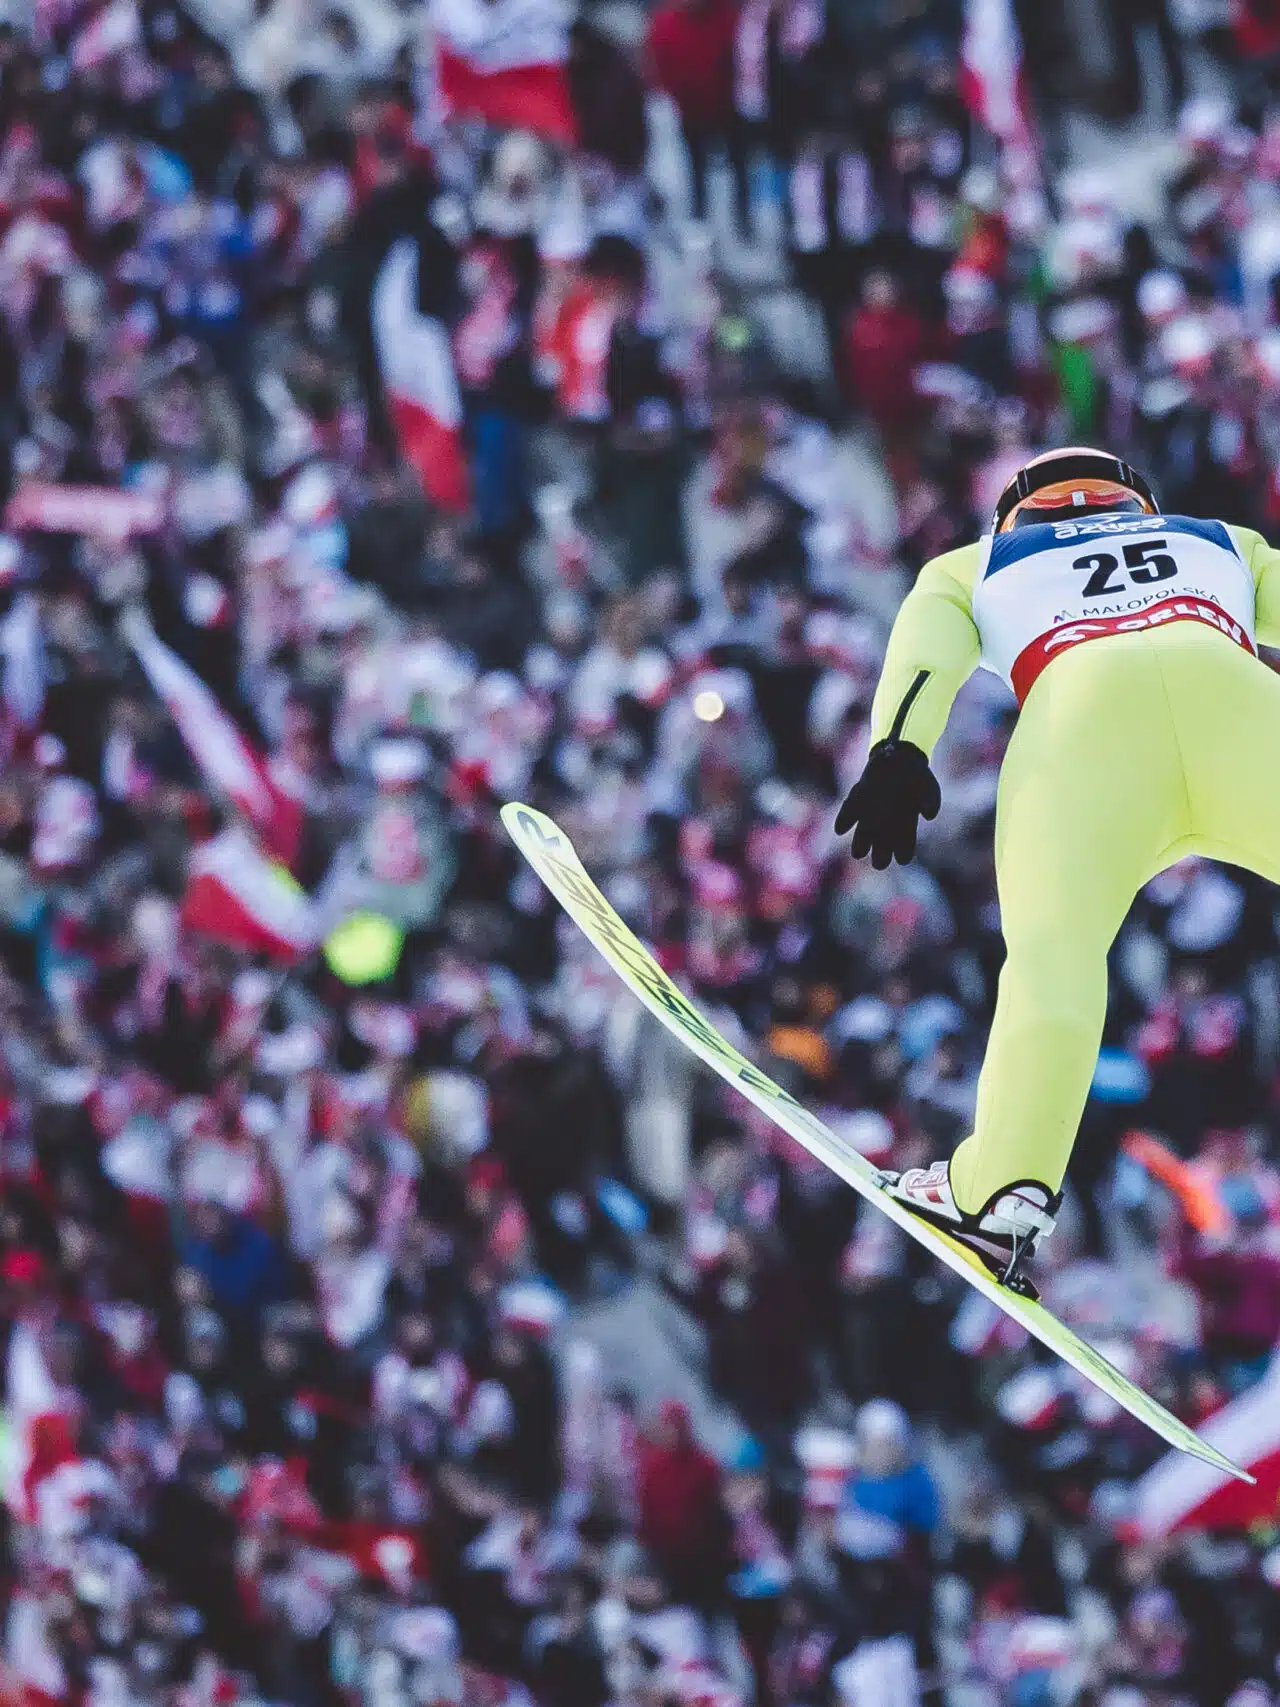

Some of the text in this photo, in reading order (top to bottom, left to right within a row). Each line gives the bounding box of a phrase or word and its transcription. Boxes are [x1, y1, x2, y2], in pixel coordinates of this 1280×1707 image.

[1072, 540, 1178, 598] 25
[1083, 587, 1221, 616] MAŁOPOLSKA
[1116, 604, 1242, 645] ORLEN
